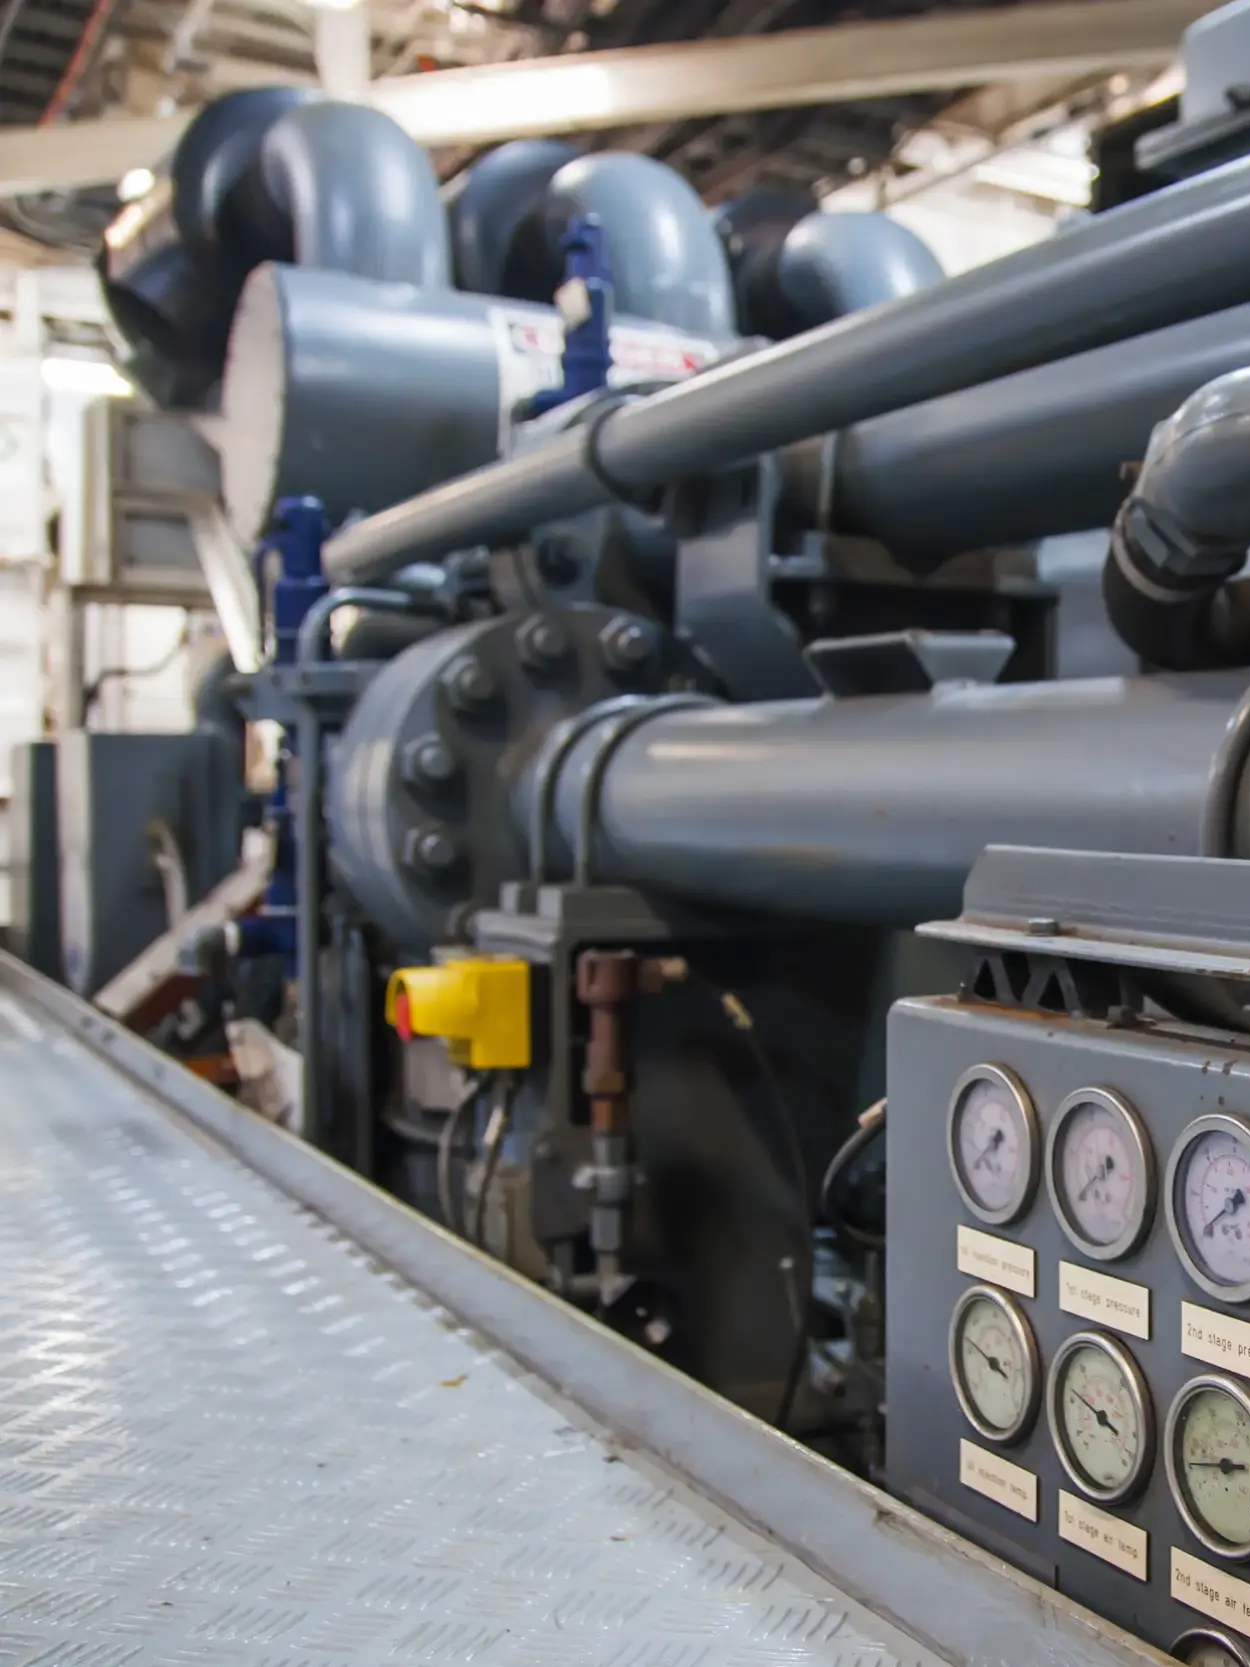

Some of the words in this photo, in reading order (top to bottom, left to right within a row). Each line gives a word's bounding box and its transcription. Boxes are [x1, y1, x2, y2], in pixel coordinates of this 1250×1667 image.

[1081, 1288, 1101, 1306] stage
[1106, 1297, 1140, 1318] pressure
[1187, 1323, 1203, 1340] 2nd
[1208, 1332, 1232, 1353] stage
[1175, 1568, 1191, 1586] 2nd
[1195, 1578, 1220, 1602] stage
[1225, 1592, 1237, 1609] air
